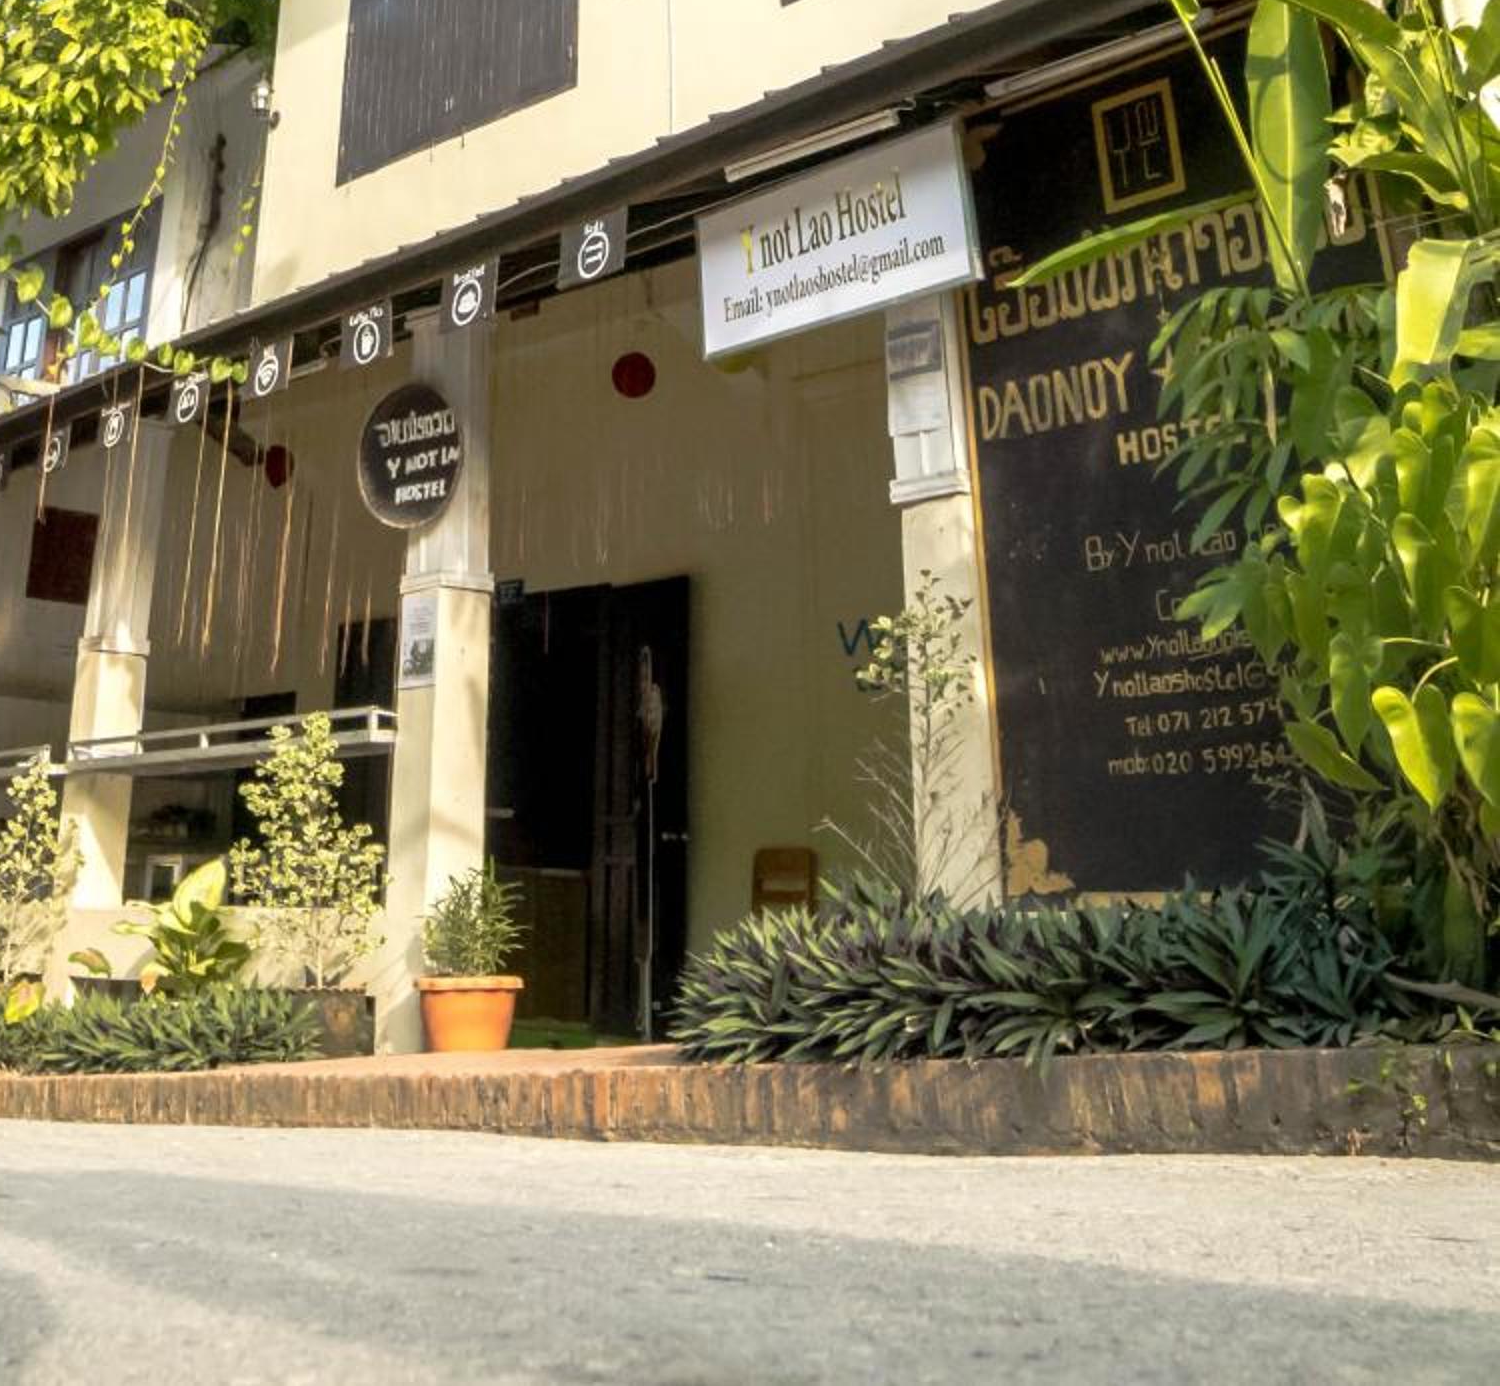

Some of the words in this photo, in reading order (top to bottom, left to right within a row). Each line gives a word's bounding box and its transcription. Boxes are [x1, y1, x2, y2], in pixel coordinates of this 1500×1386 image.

[740, 224, 755, 277] Y
[760, 217, 793, 269] not
[794, 207, 833, 256] Lao
[834, 165, 908, 241] Hostel
[723, 284, 763, 322] Email:
[979, 351, 1134, 441] DAONOY
[1116, 413, 1246, 465] HOSTE
[386, 457, 401, 479] Y
[404, 449, 439, 475] NOT
[394, 479, 446, 506] HOSTEL
[1117, 530, 1141, 567] Y
[1156, 709, 1190, 733] 071
[1201, 706, 1234, 729] 212
[1239, 697, 1284, 724] 574
[1152, 750, 1192, 775] 020
